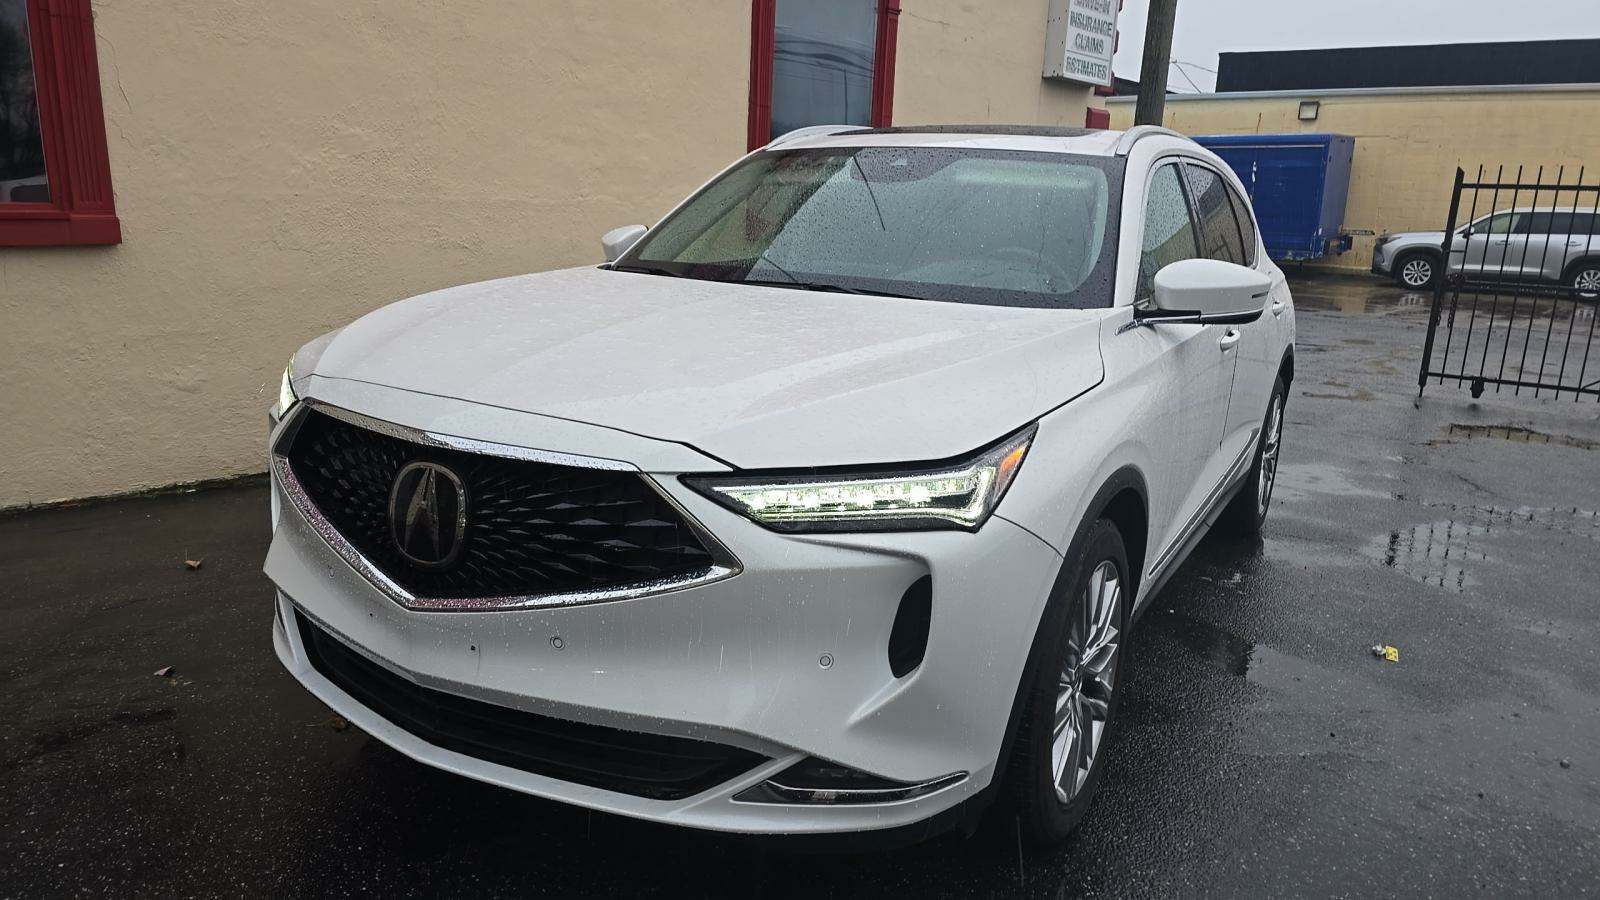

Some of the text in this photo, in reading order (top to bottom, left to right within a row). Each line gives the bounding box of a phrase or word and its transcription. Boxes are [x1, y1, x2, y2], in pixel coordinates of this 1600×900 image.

[1070, 11, 1112, 37] INSURANCE
[1075, 33, 1104, 54] CLAIMS
[1066, 56, 1107, 80] ESTIMATES
